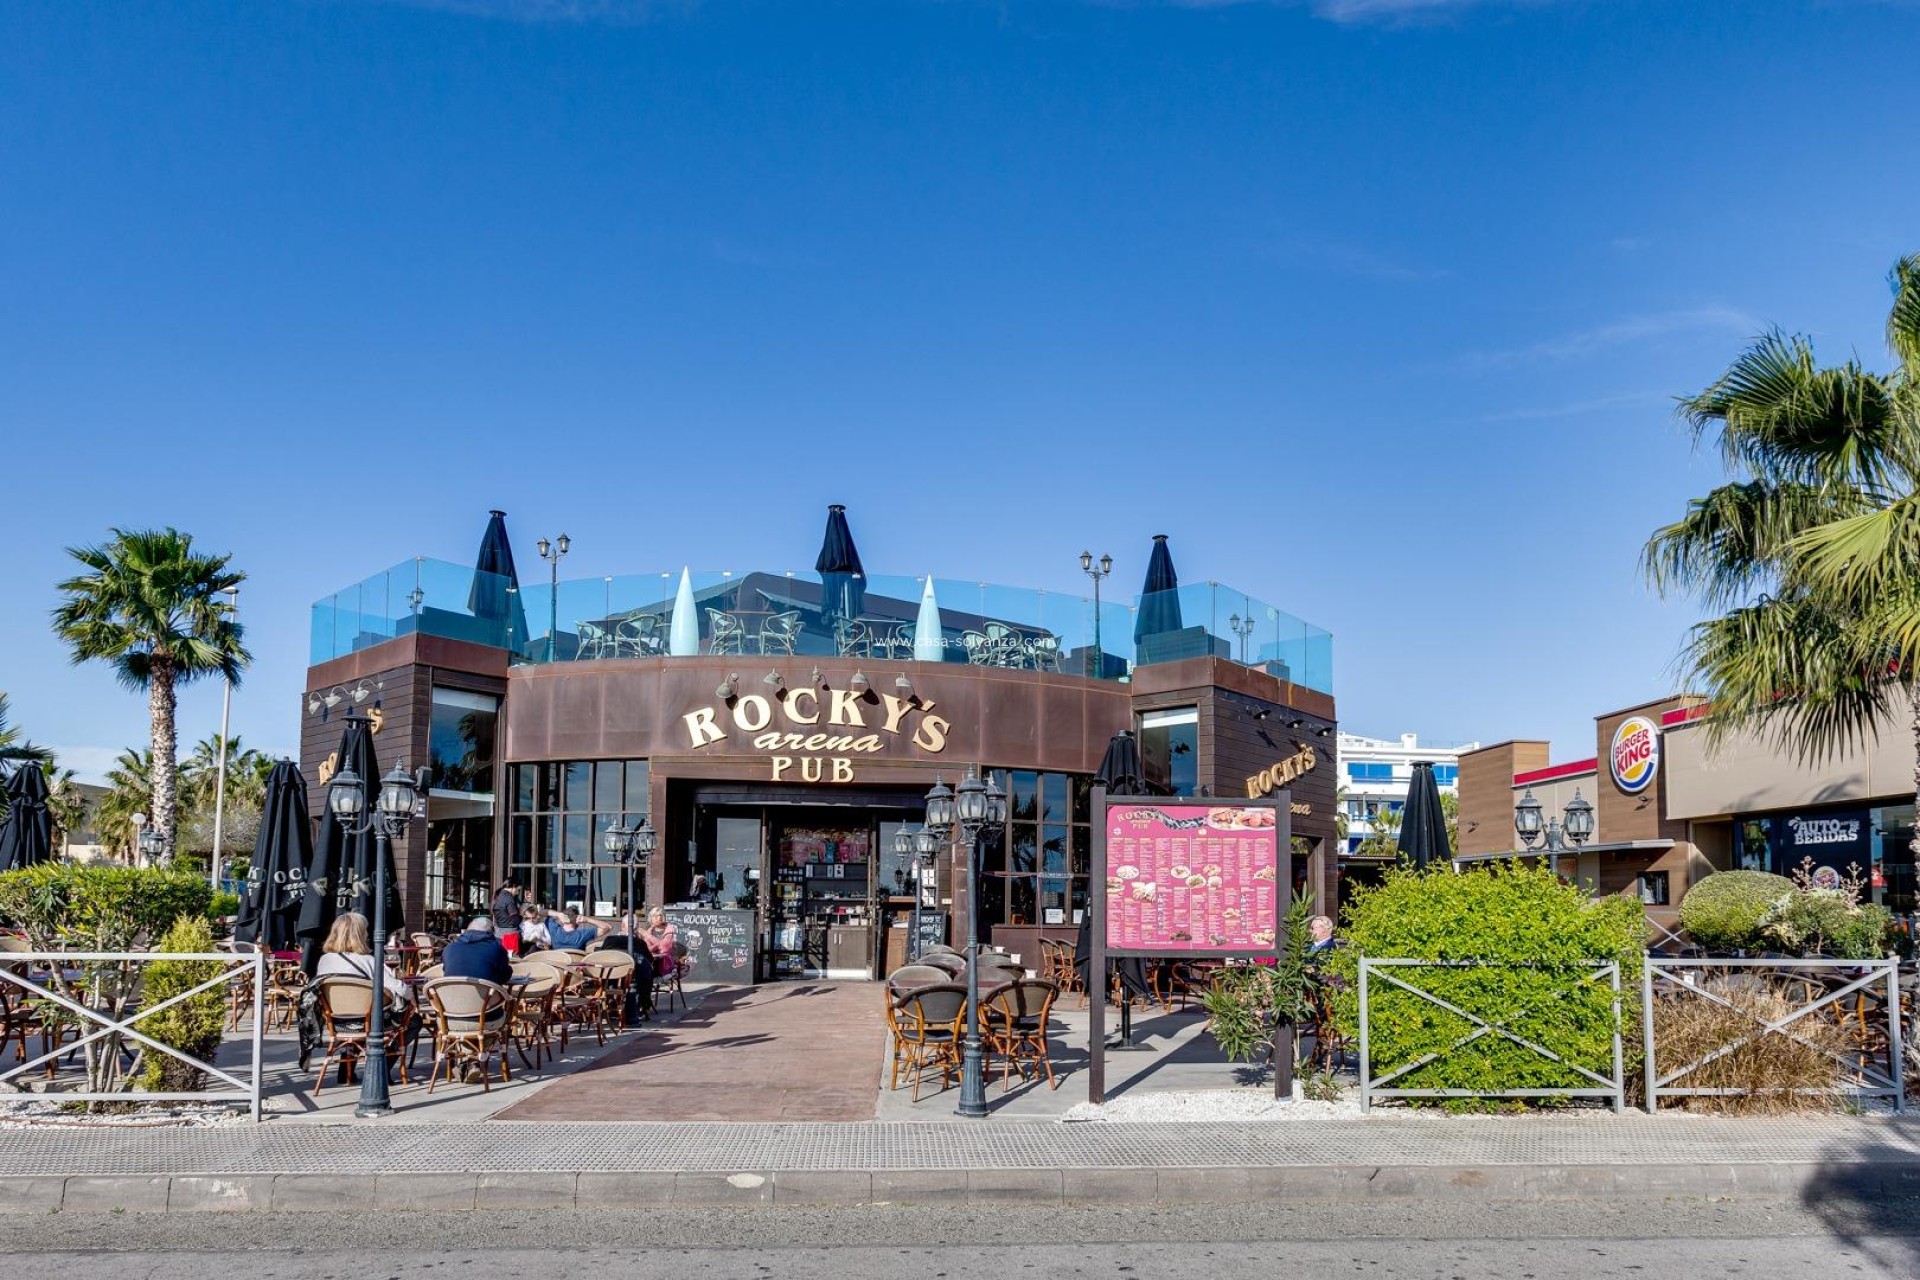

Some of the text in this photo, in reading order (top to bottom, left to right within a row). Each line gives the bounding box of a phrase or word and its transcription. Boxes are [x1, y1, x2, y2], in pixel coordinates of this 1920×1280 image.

[682, 687, 951, 753] ROCKY'S
[754, 731, 885, 752] arena
[1615, 729, 1649, 759] BURGER
[771, 756, 856, 783] PUB
[1246, 743, 1317, 800] ROCKY'S
[1617, 741, 1650, 777] KING
[1794, 829, 1858, 845] BEBIDAS
[1797, 818, 1841, 833] AUTO
